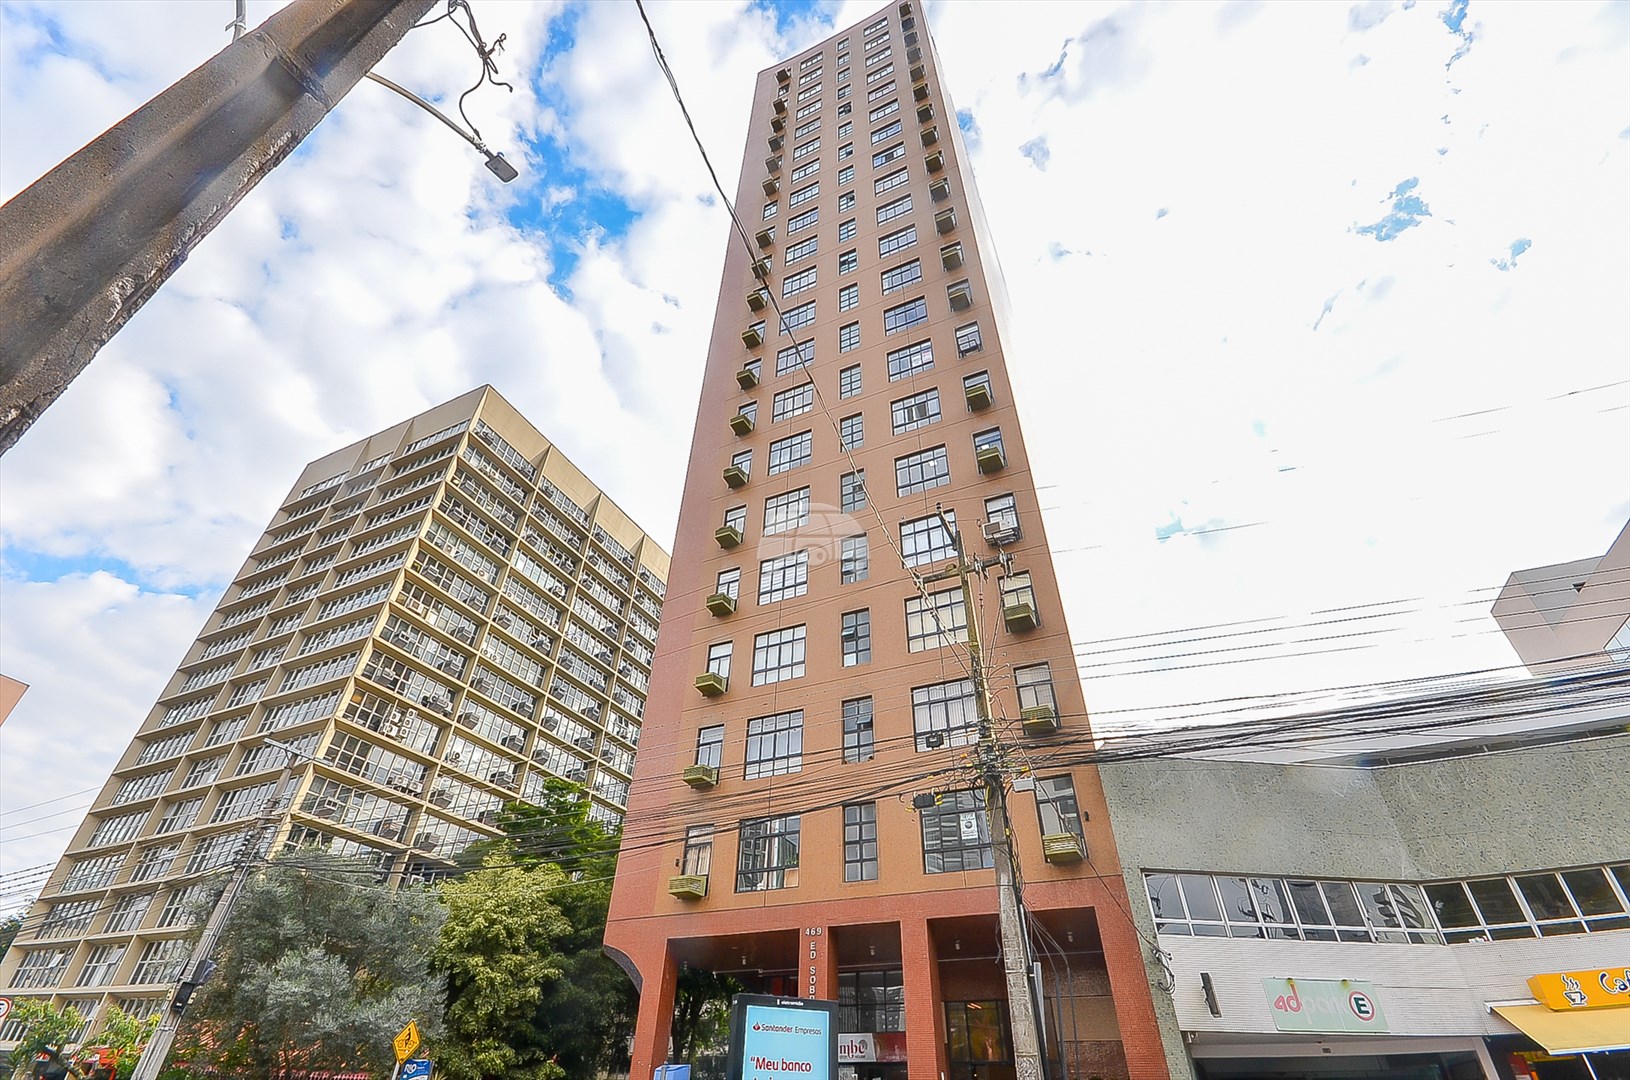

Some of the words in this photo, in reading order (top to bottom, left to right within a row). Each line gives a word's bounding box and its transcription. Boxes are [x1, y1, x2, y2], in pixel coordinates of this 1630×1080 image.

[805, 927, 822, 936] 469
[810, 942, 816, 959] ED
[761, 1023, 793, 1034] Santander
[795, 1027, 822, 1036] Empresas
[781, 1058, 812, 1072] banco
